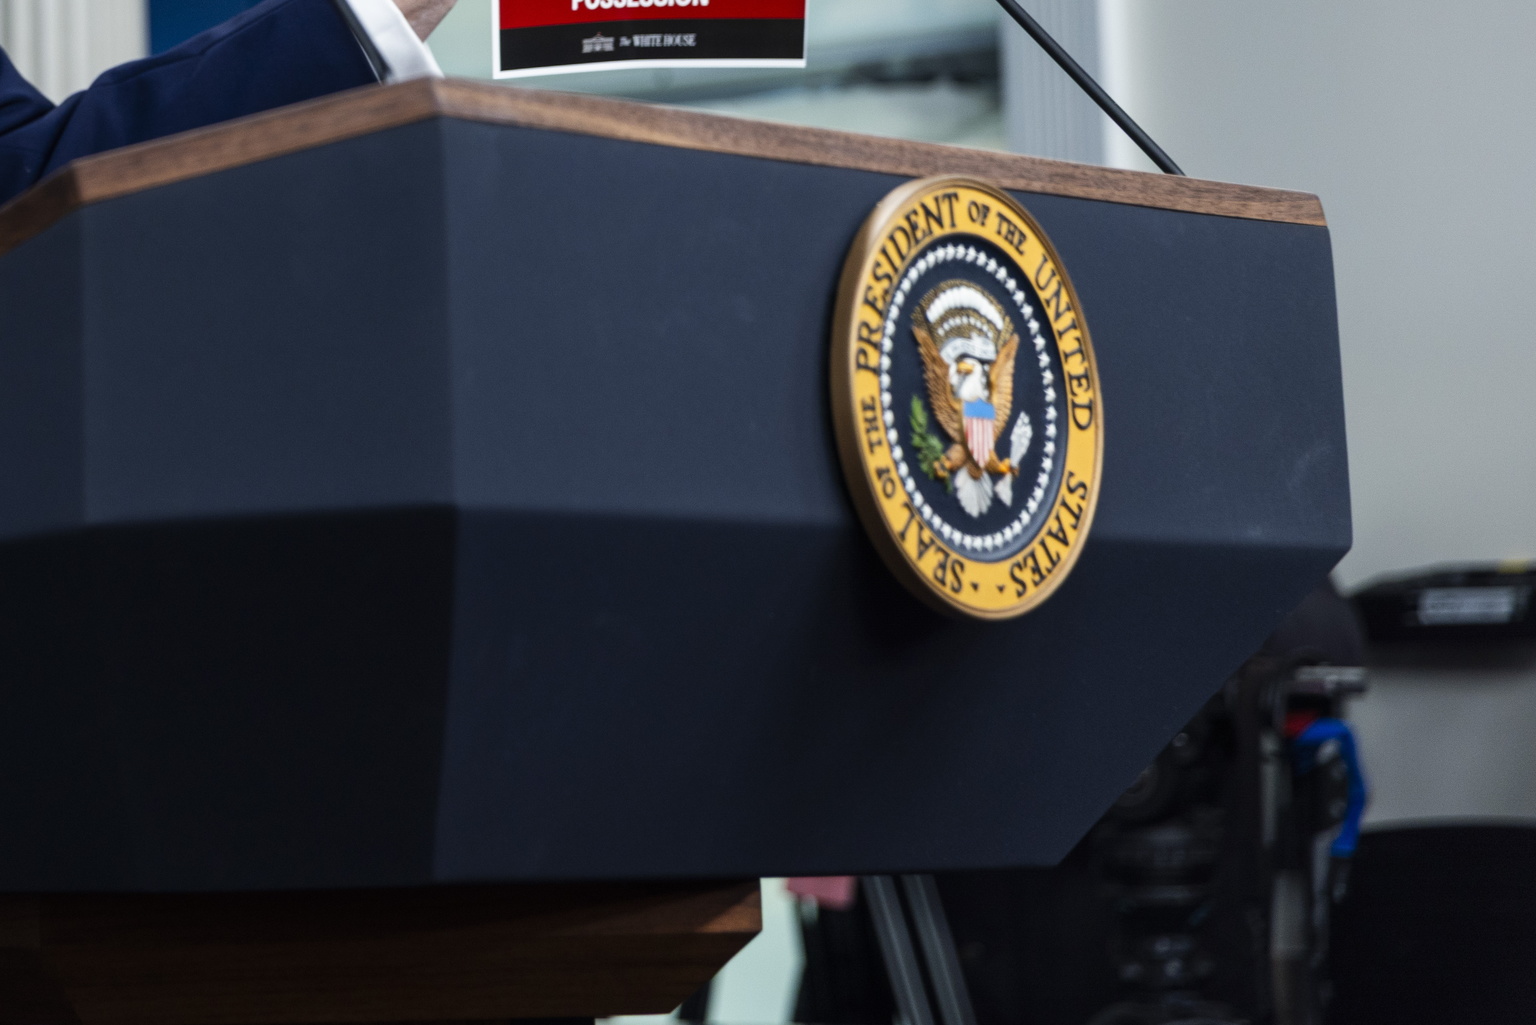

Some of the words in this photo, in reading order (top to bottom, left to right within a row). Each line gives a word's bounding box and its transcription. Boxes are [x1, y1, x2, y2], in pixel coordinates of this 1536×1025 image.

[967, 200, 991, 227] OF
[995, 211, 1029, 256] THE
[856, 191, 959, 375] PRESIDENT
[1035, 252, 1094, 431] UNITED
[860, 396, 883, 454] THE
[875, 466, 896, 499] OF
[897, 502, 965, 594] SEAL
[1009, 470, 1088, 597] STATES
